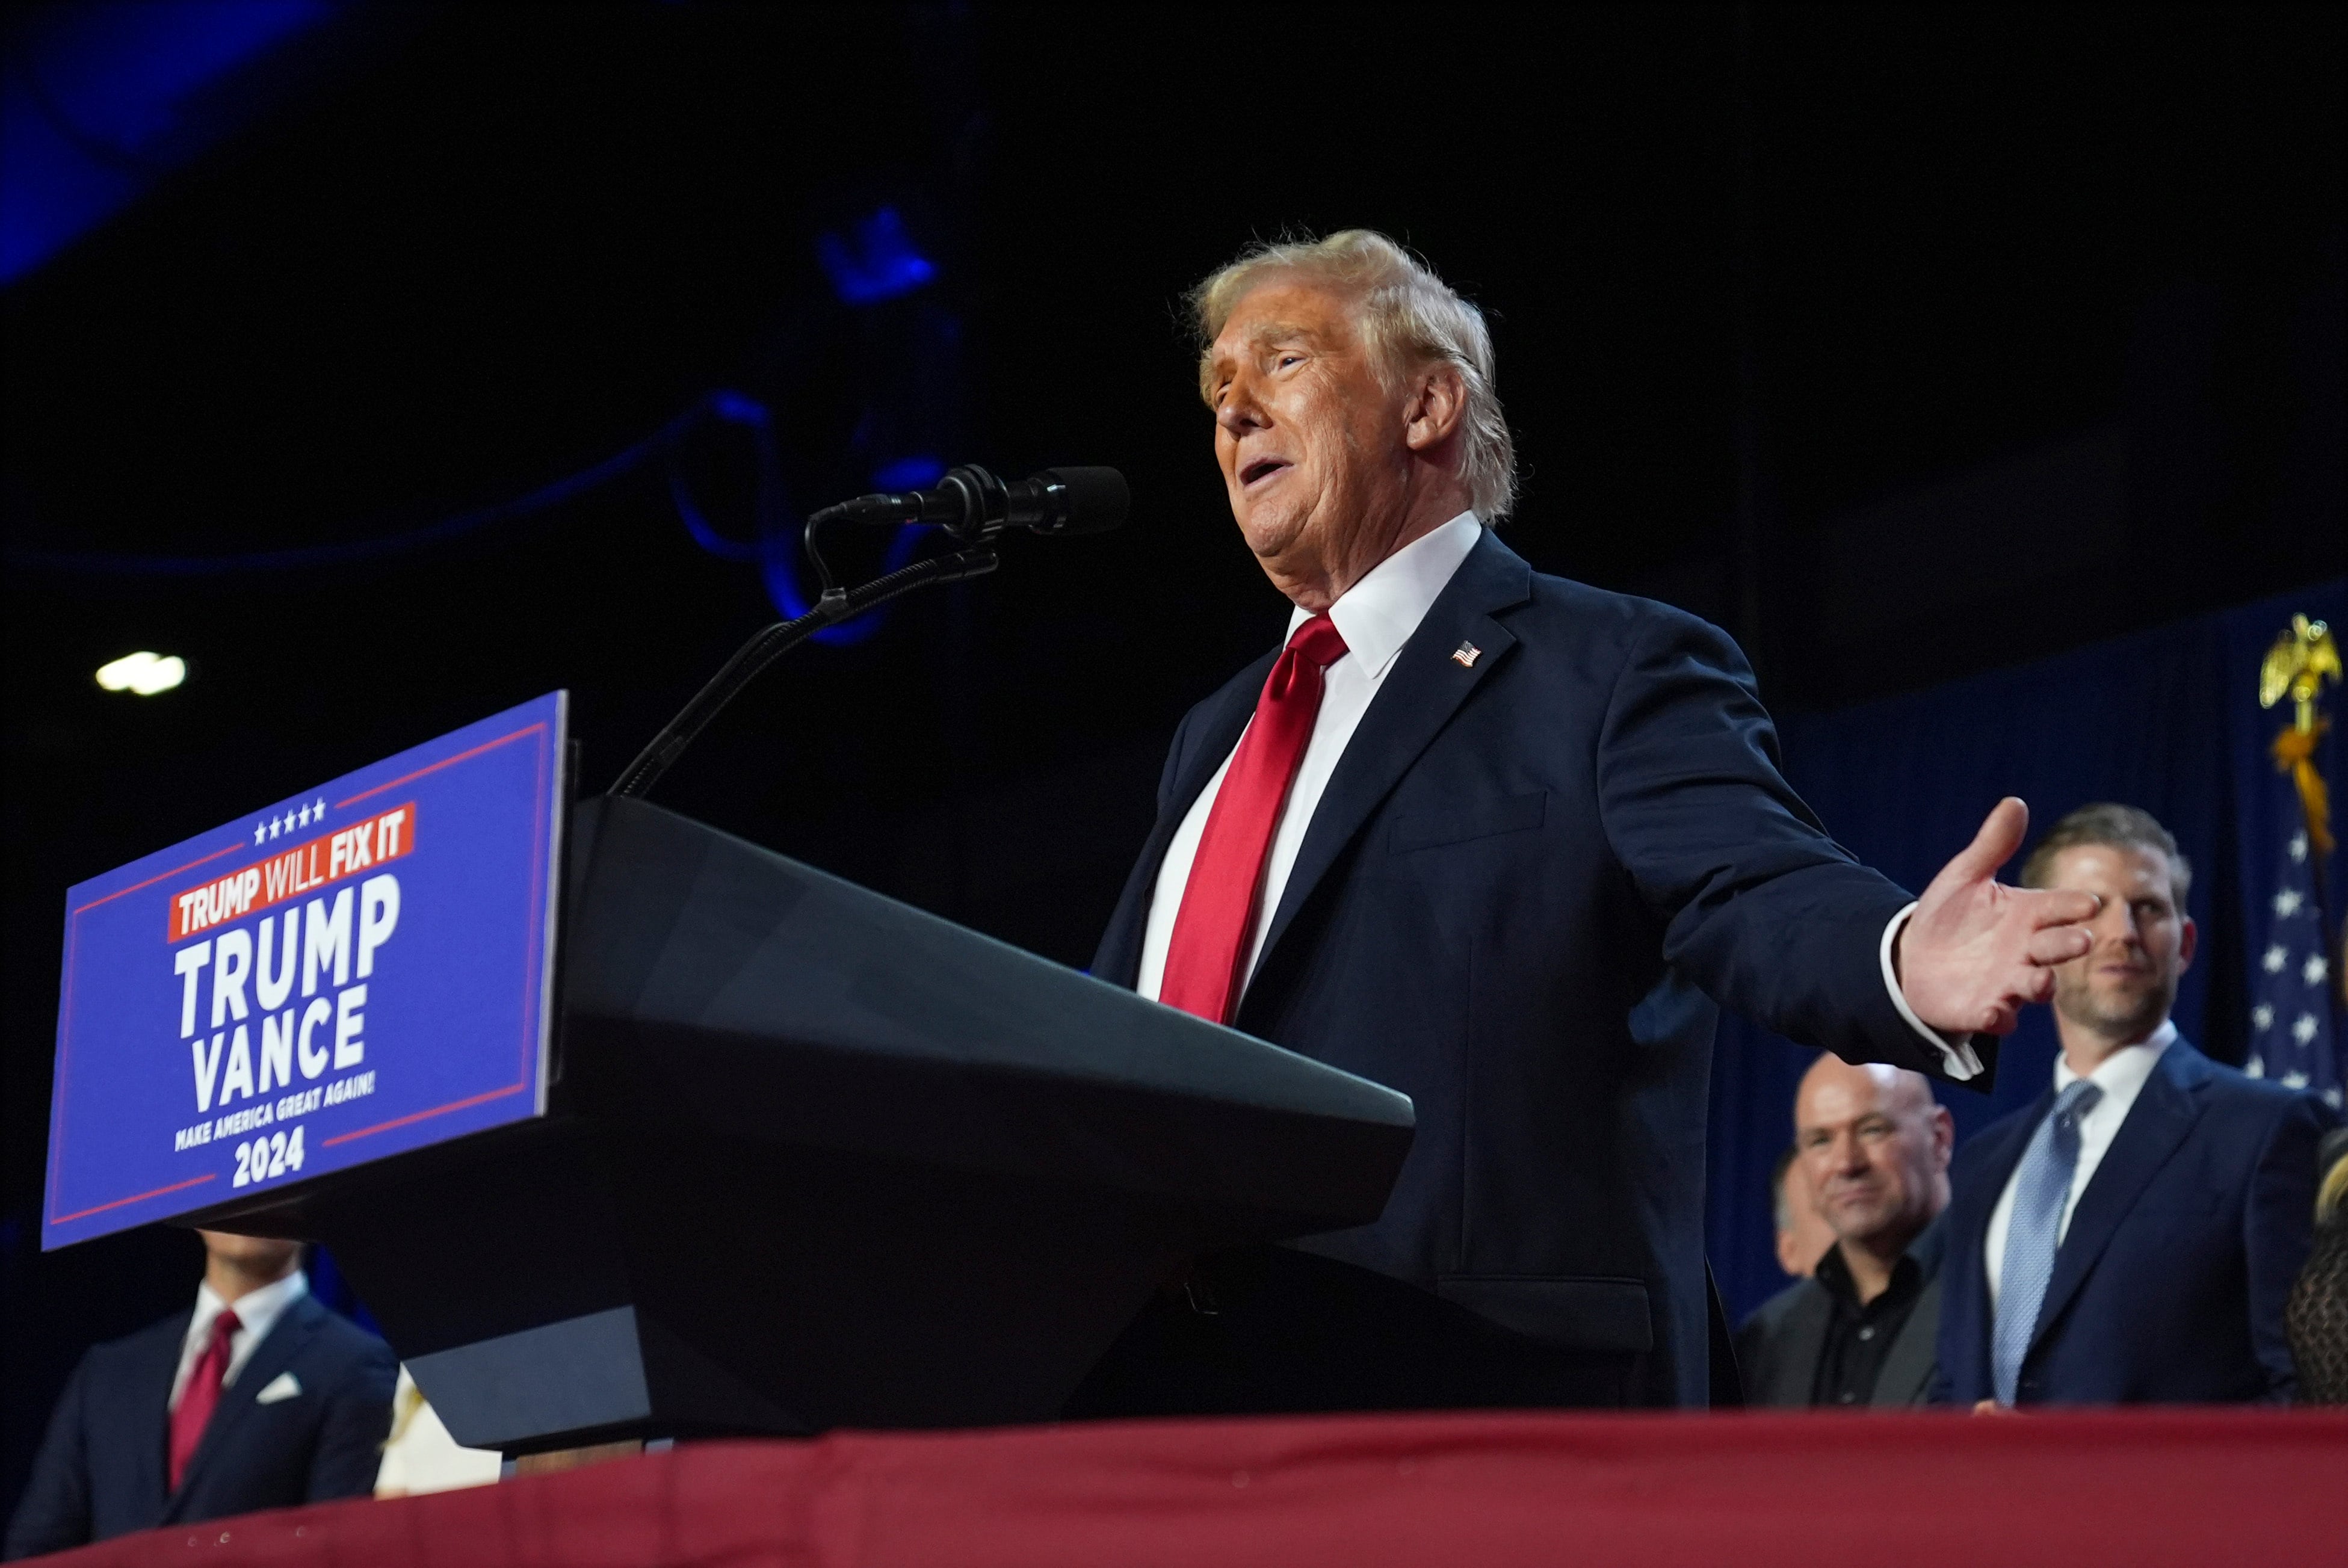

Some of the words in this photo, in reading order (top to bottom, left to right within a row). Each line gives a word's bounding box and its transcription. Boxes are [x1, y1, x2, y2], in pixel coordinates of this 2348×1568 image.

[179, 867, 260, 935] TRUMP
[265, 844, 324, 902] WILL
[329, 821, 374, 879] FIX
[377, 809, 405, 861] IT
[175, 874, 401, 1039] TRUMP
[175, 1121, 212, 1152] MAKE
[213, 1102, 274, 1140] AMERICA
[276, 1086, 323, 1121] GREAT
[323, 1070, 375, 1107] AGAIN!
[192, 984, 368, 1113] VANCE
[232, 1125, 304, 1188] 2024
